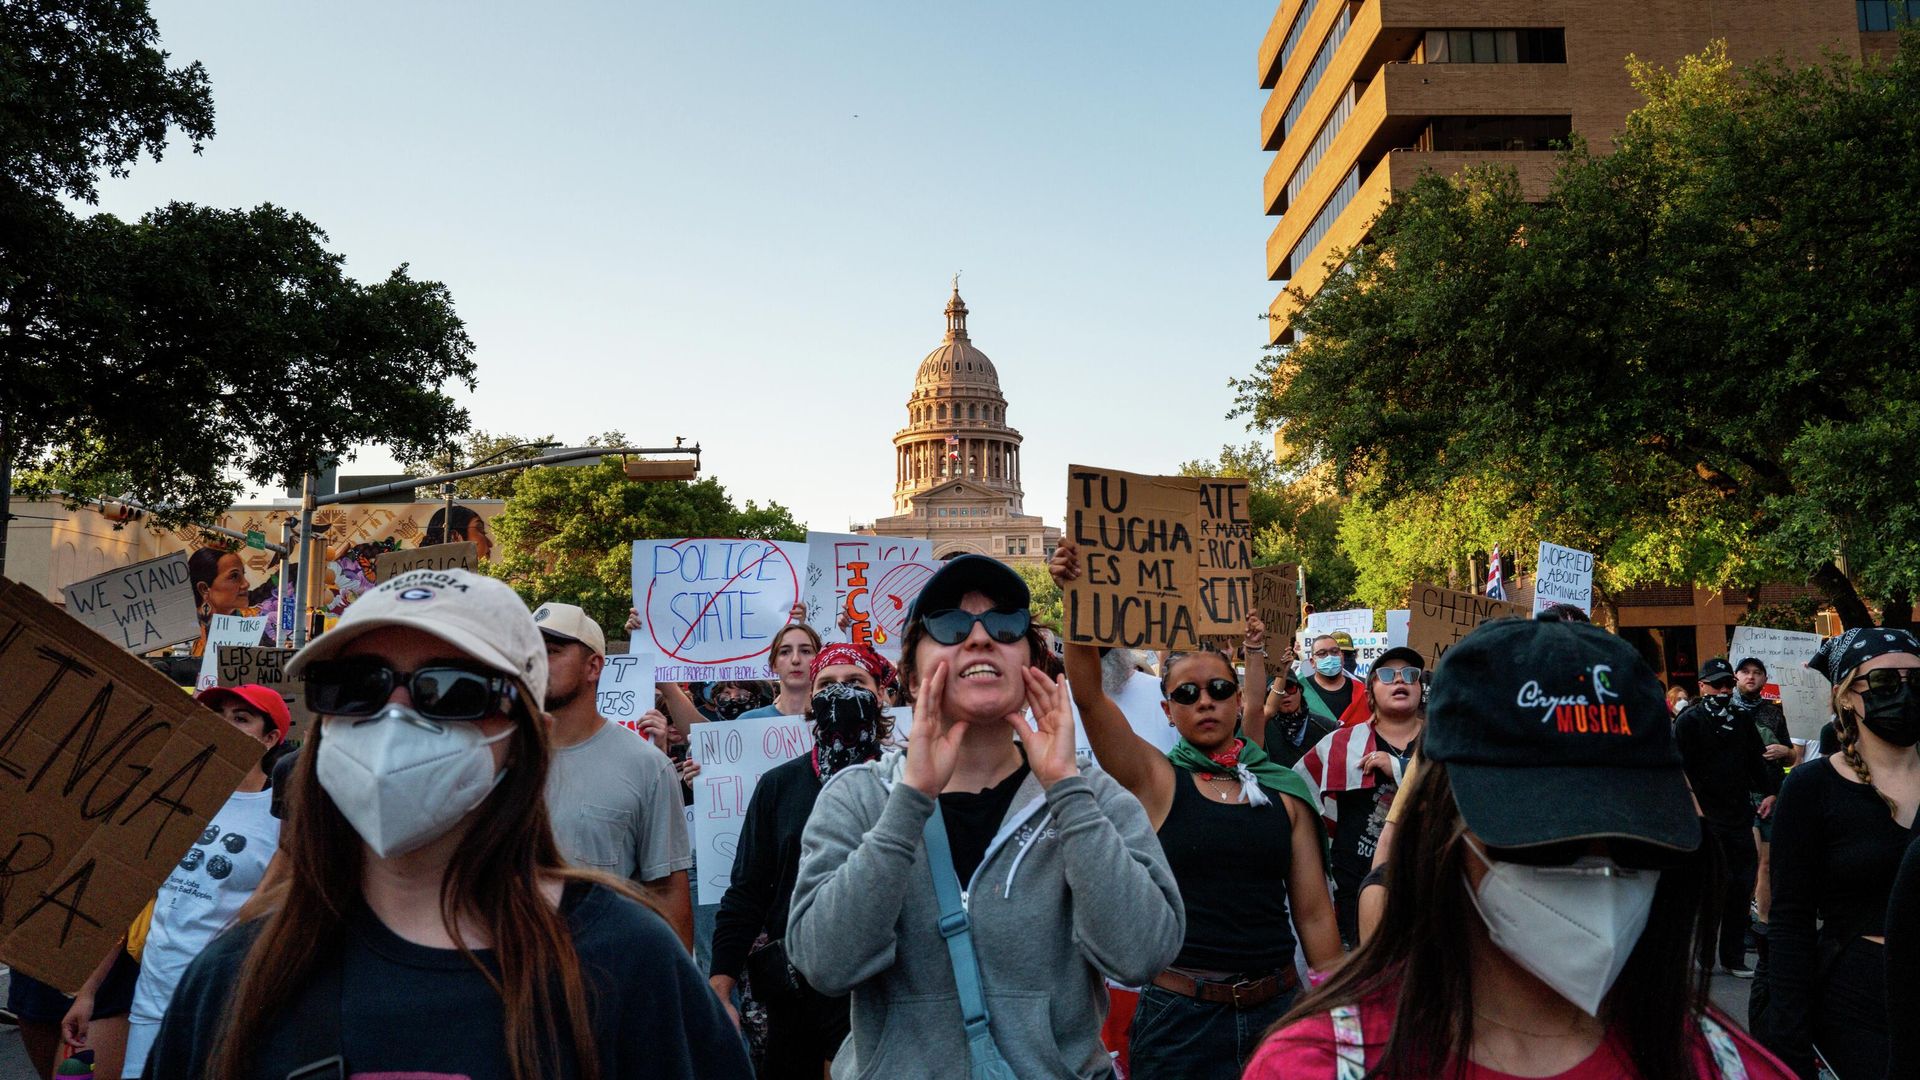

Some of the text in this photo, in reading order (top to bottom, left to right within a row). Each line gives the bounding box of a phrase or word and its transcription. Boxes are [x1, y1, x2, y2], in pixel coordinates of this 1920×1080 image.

[1072, 472, 1128, 514] TU
[1200, 483, 1250, 524] ATE
[1074, 510, 1192, 554] LUCHA
[1216, 522, 1252, 541] MADE
[390, 556, 470, 579] AMERICA
[654, 542, 782, 587] POLICE
[1199, 538, 1252, 570] ERICA
[1541, 545, 1594, 573] WORRIED
[70, 561, 191, 613] WE STAND
[380, 572, 471, 593] GEORGIA
[1087, 553, 1178, 592] ES MI
[1547, 568, 1581, 586] ABOUT
[846, 561, 873, 647] ICE
[1199, 576, 1250, 624] REAT
[1537, 578, 1590, 601] CRIMINALS?
[112, 598, 157, 627] WITH
[670, 589, 768, 651] STATE
[1070, 589, 1198, 649] LUCHA
[1260, 607, 1294, 637] AGAINST
[1311, 611, 1367, 630] IMPEACH
[1422, 588, 1515, 628] CHIN
[123, 619, 162, 649] LA
[237, 618, 261, 633] take
[1363, 648, 1376, 660] BE
[223, 665, 250, 686] UP
[257, 667, 283, 685] AND
[734, 665, 759, 680] PEOPLE
[1517, 680, 1589, 723] Cirque
[1556, 704, 1632, 736] MUSICA
[0, 622, 218, 860] INGA
[700, 728, 743, 766] NO
[184, 879, 200, 889] Jobs
[191, 889, 213, 901] Apples
